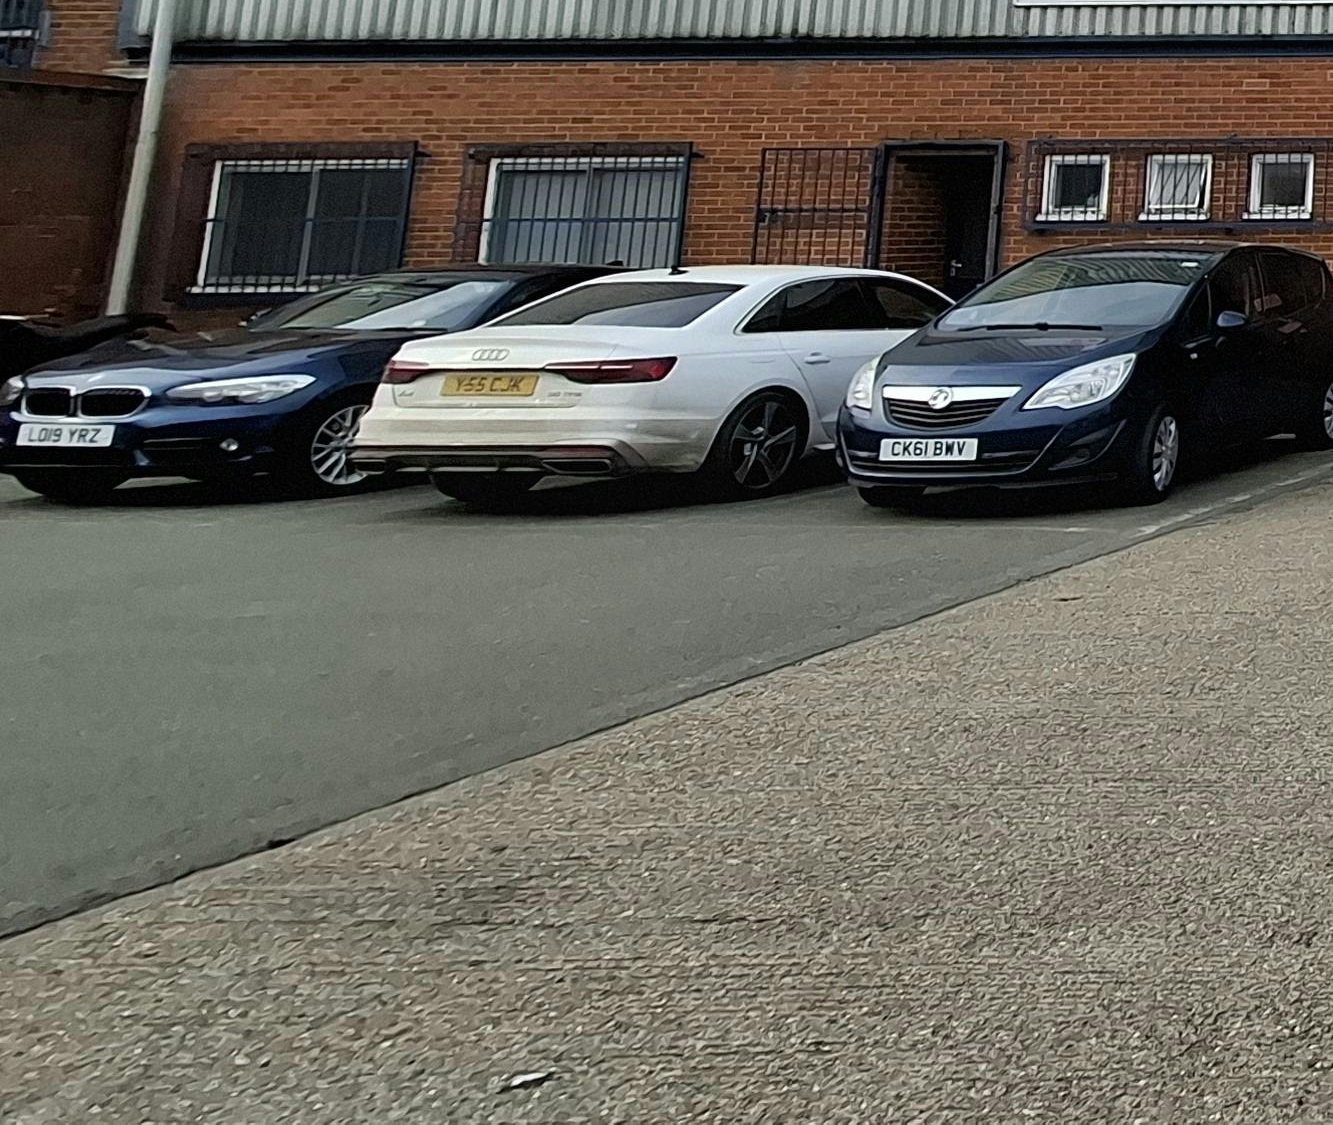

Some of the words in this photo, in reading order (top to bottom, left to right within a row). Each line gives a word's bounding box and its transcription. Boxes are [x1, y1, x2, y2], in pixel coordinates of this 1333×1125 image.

[68, 428, 102, 443] YRZ
[891, 441, 928, 456] CK61
[933, 441, 967, 456] BWV
